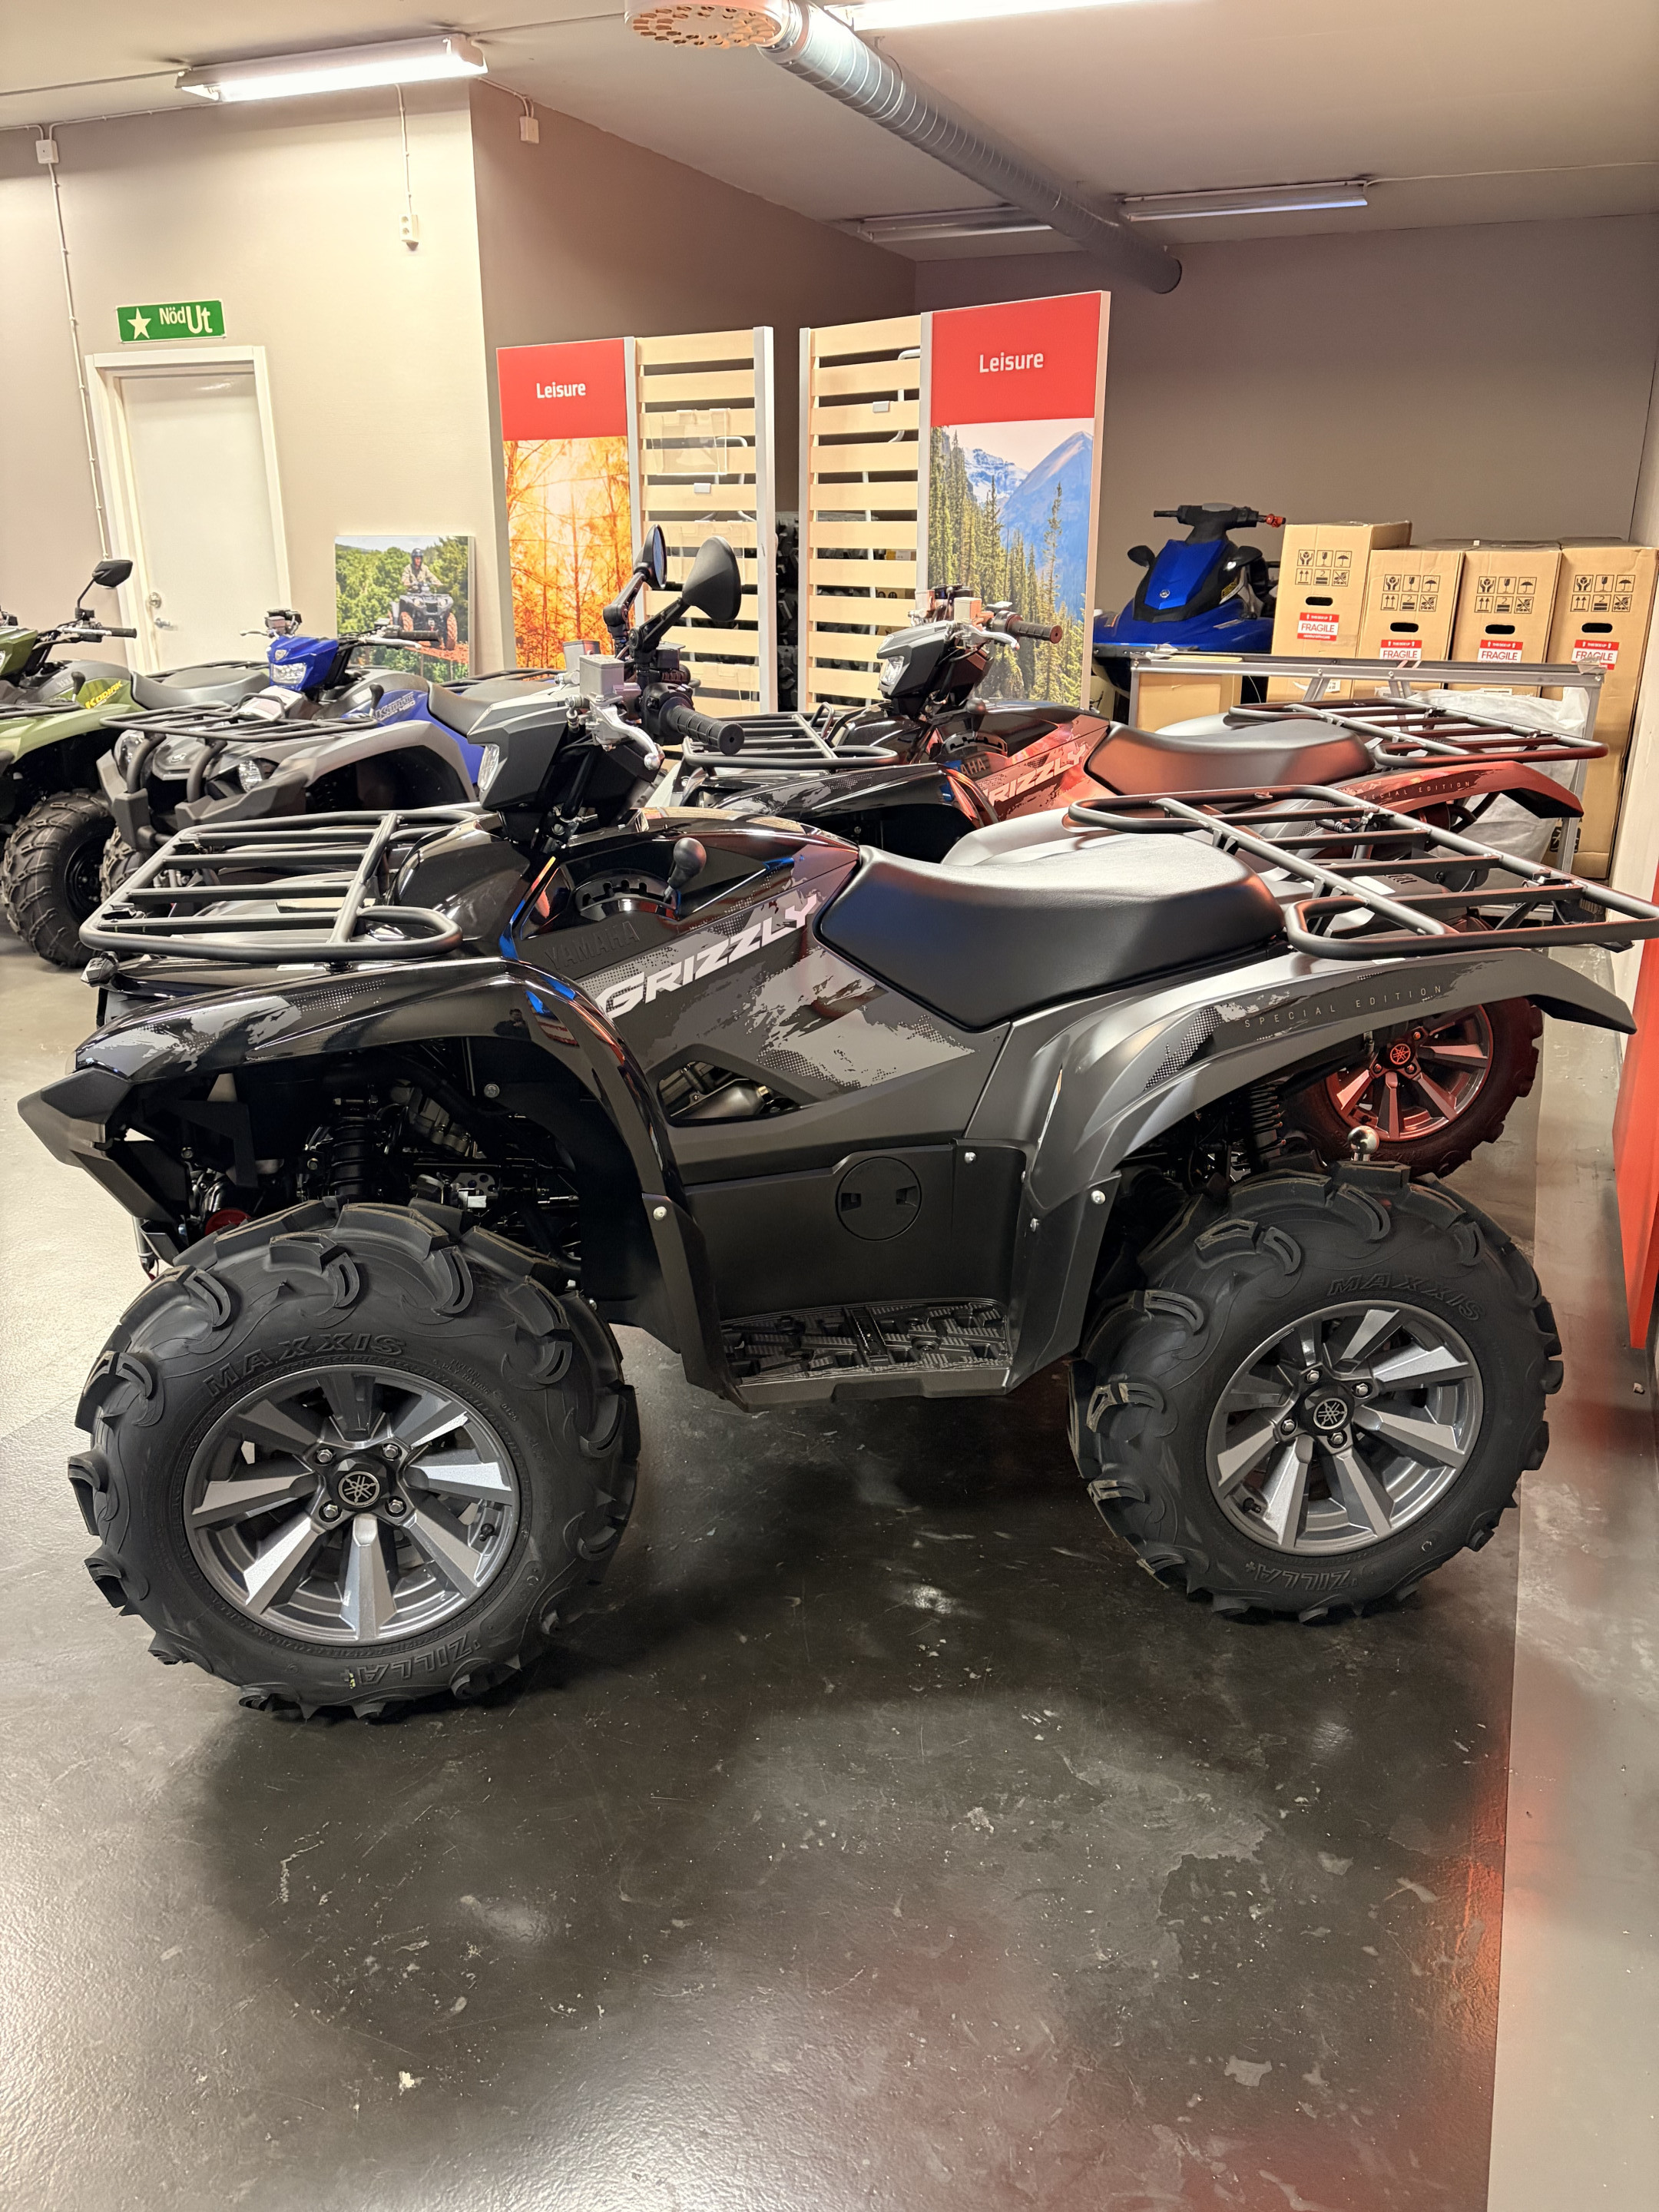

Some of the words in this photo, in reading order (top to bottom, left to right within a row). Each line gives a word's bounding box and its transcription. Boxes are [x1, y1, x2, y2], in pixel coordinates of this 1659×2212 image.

[979, 351, 1044, 373] Leisure
[535, 381, 586, 399] Leisure
[1300, 622, 1335, 633] FRAGILE
[1382, 650, 1418, 659] FRAGILE
[1481, 650, 1518, 661] FRAGILE
[1575, 651, 1614, 661] FRAGILE
[982, 743, 1087, 807] RIZZLY
[1363, 789, 1408, 800] PECIAL
[1419, 781, 1470, 793] EDITION
[543, 920, 641, 971] YAMAHA
[594, 893, 818, 1021] GRIZZLY
[1243, 1004, 1336, 1028] SPECIAL
[1356, 985, 1442, 1008] EDITION
[1326, 1272, 1480, 1320] MAXXIS
[203, 1333, 406, 1399] MAXXIS
